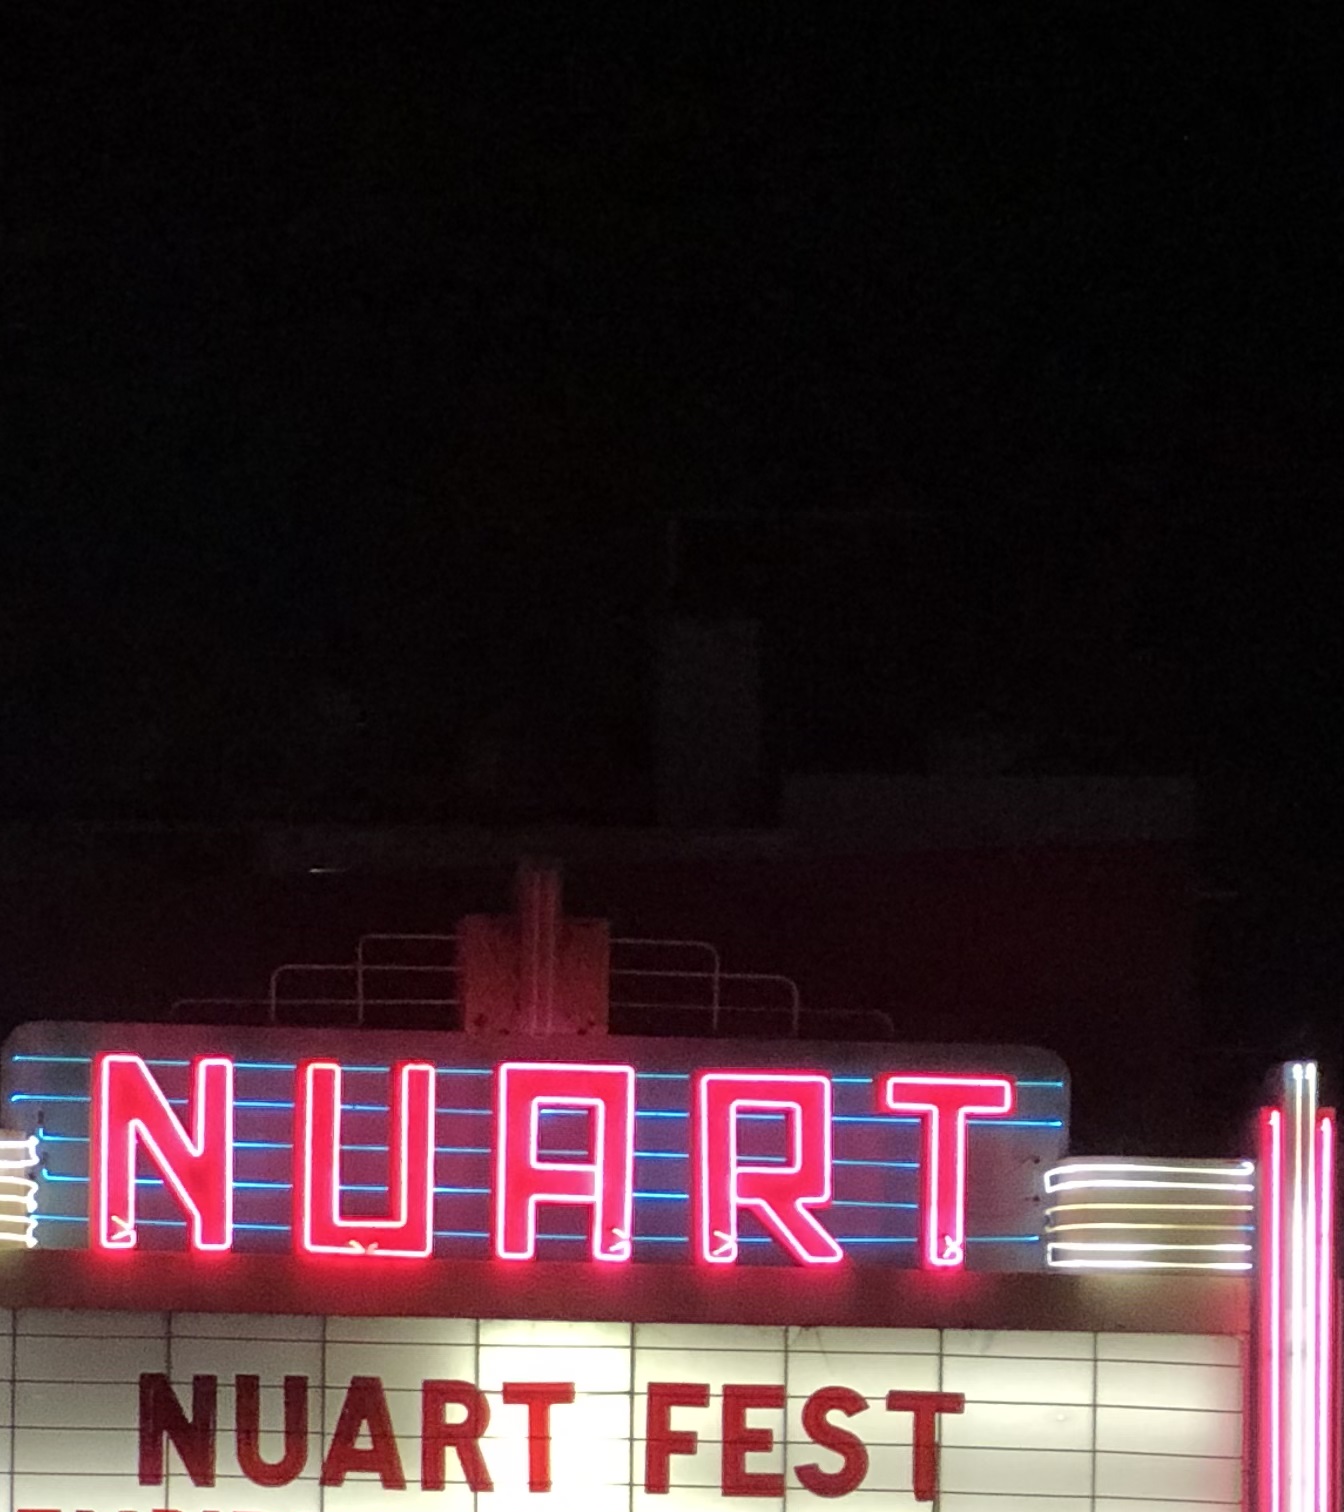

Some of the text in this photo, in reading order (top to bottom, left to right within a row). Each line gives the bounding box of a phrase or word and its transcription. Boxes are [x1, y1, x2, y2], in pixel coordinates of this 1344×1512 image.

[91, 1051, 1018, 1268] NUART
[137, 1371, 966, 1503] NUART FEST
